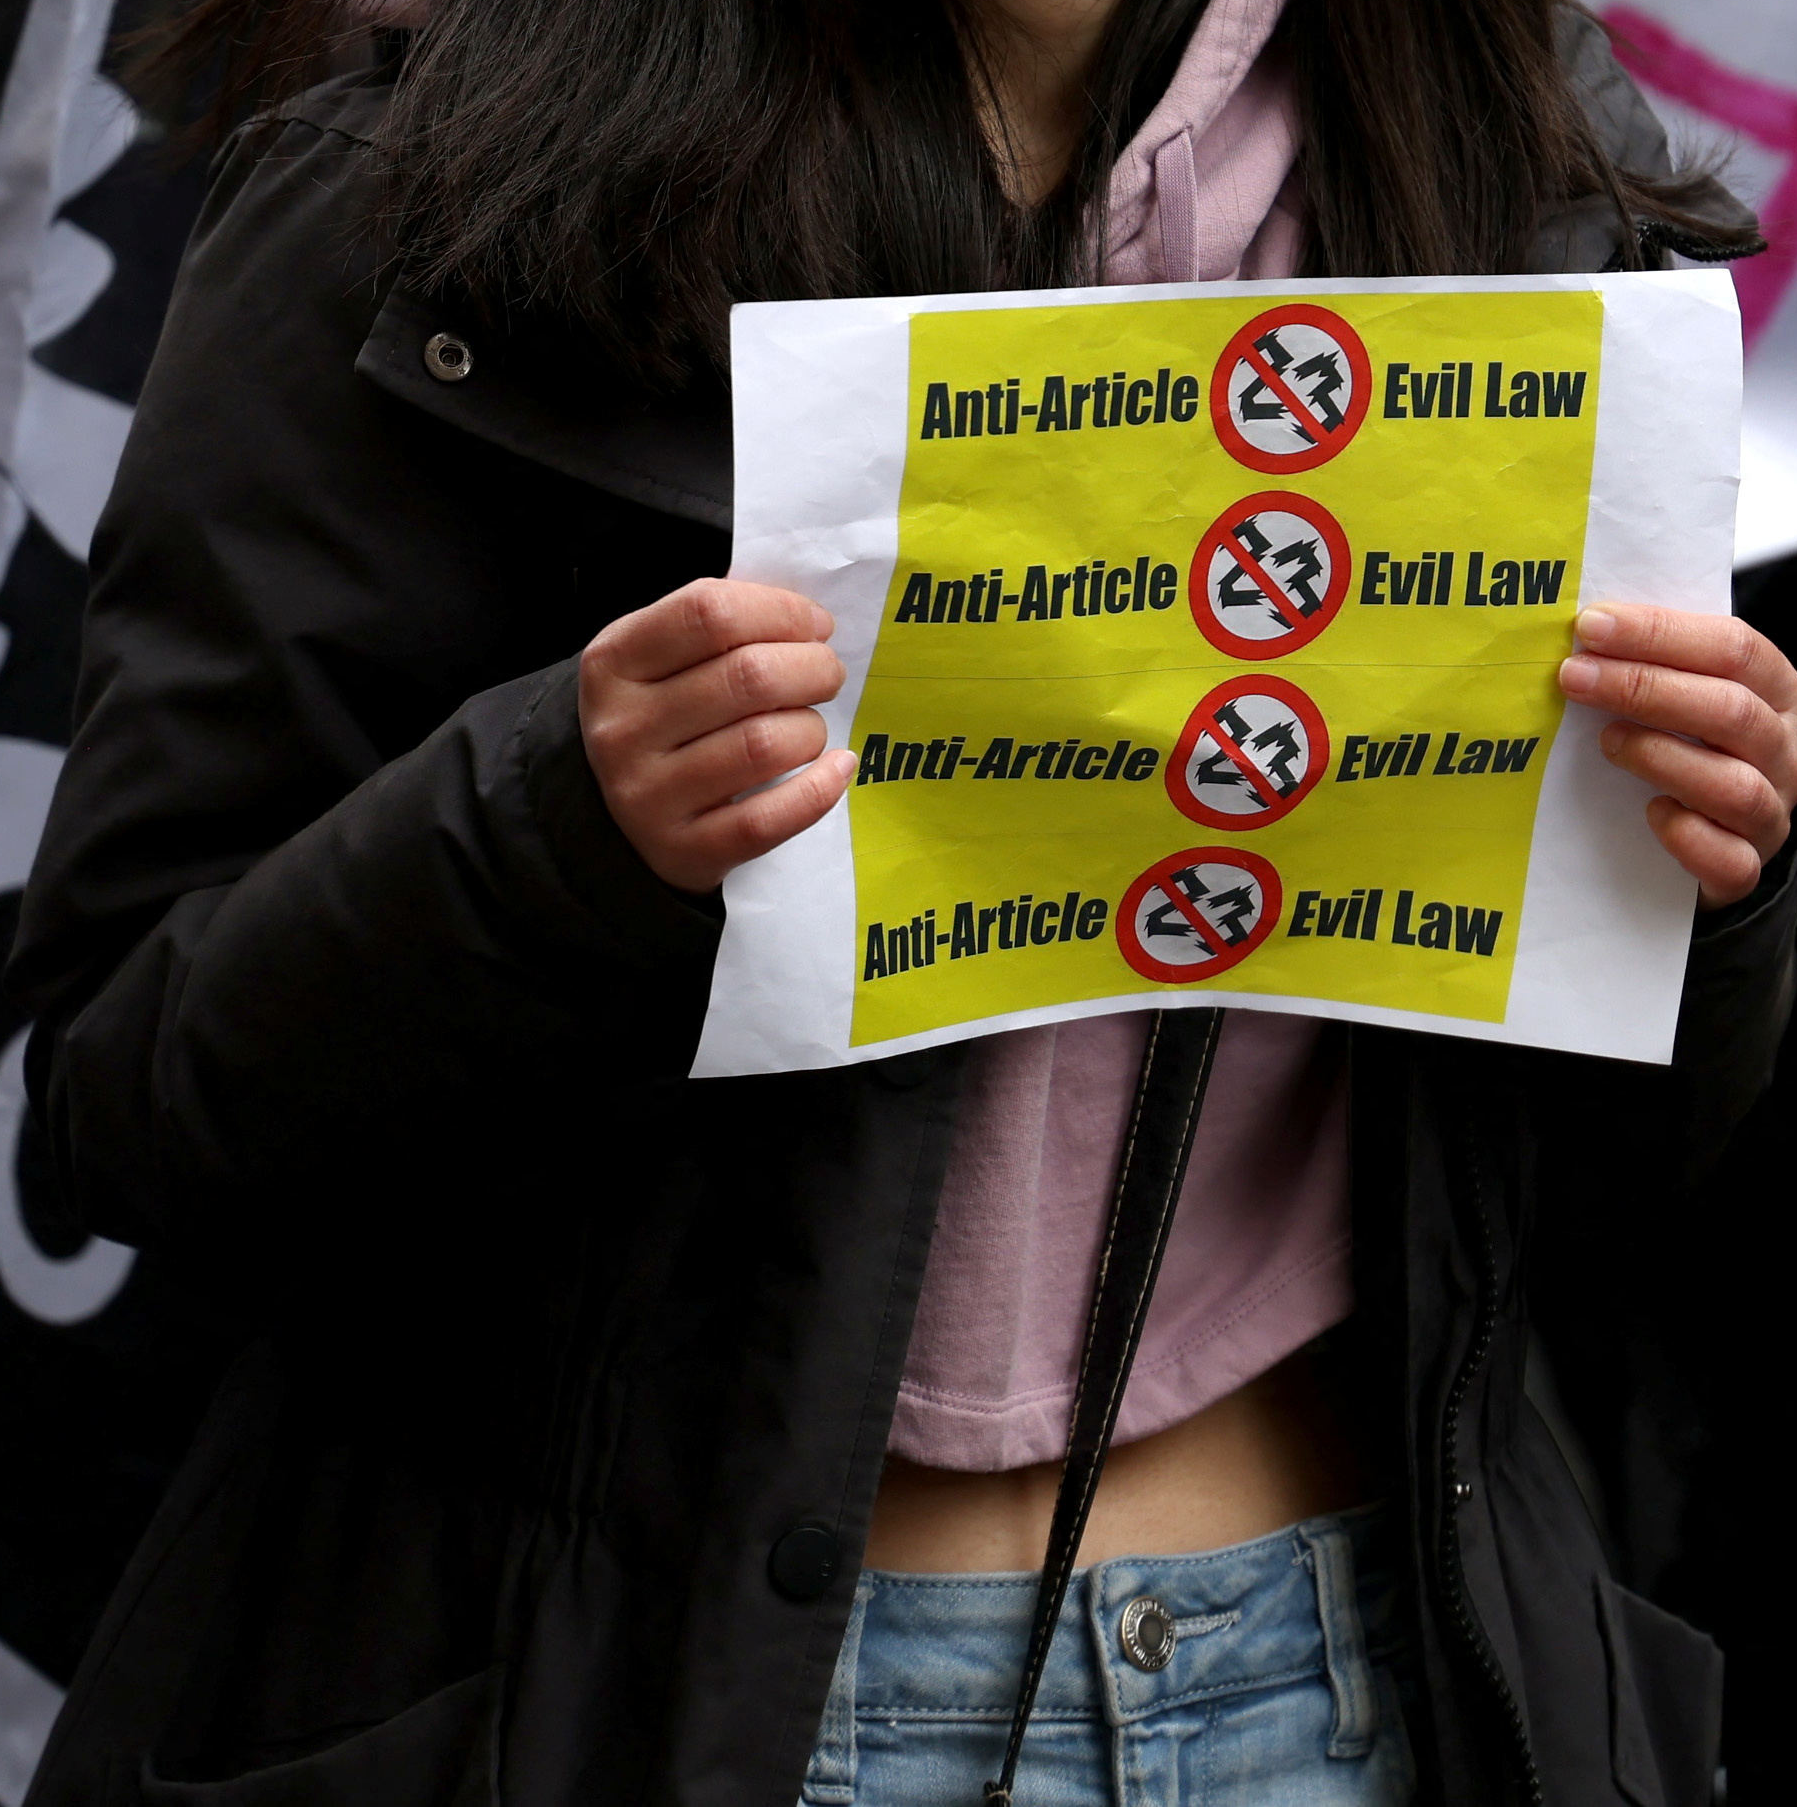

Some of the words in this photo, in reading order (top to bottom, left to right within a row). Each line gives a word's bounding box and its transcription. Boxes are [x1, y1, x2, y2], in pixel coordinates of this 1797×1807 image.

[920, 367, 1200, 441] Anti-Article
[1382, 361, 1474, 420] Evil
[1483, 361, 1588, 420] Law
[893, 555, 1179, 625] Anti-Article
[1359, 550, 1455, 607] Evil
[1463, 550, 1567, 608] Law
[855, 733, 1161, 787] Anti-Article
[1334, 732, 1432, 784] Evil
[1431, 731, 1541, 777] Law
[862, 891, 1110, 983] Anti-Article
[1286, 887, 1385, 943] Evil
[1390, 889, 1505, 958] Law
